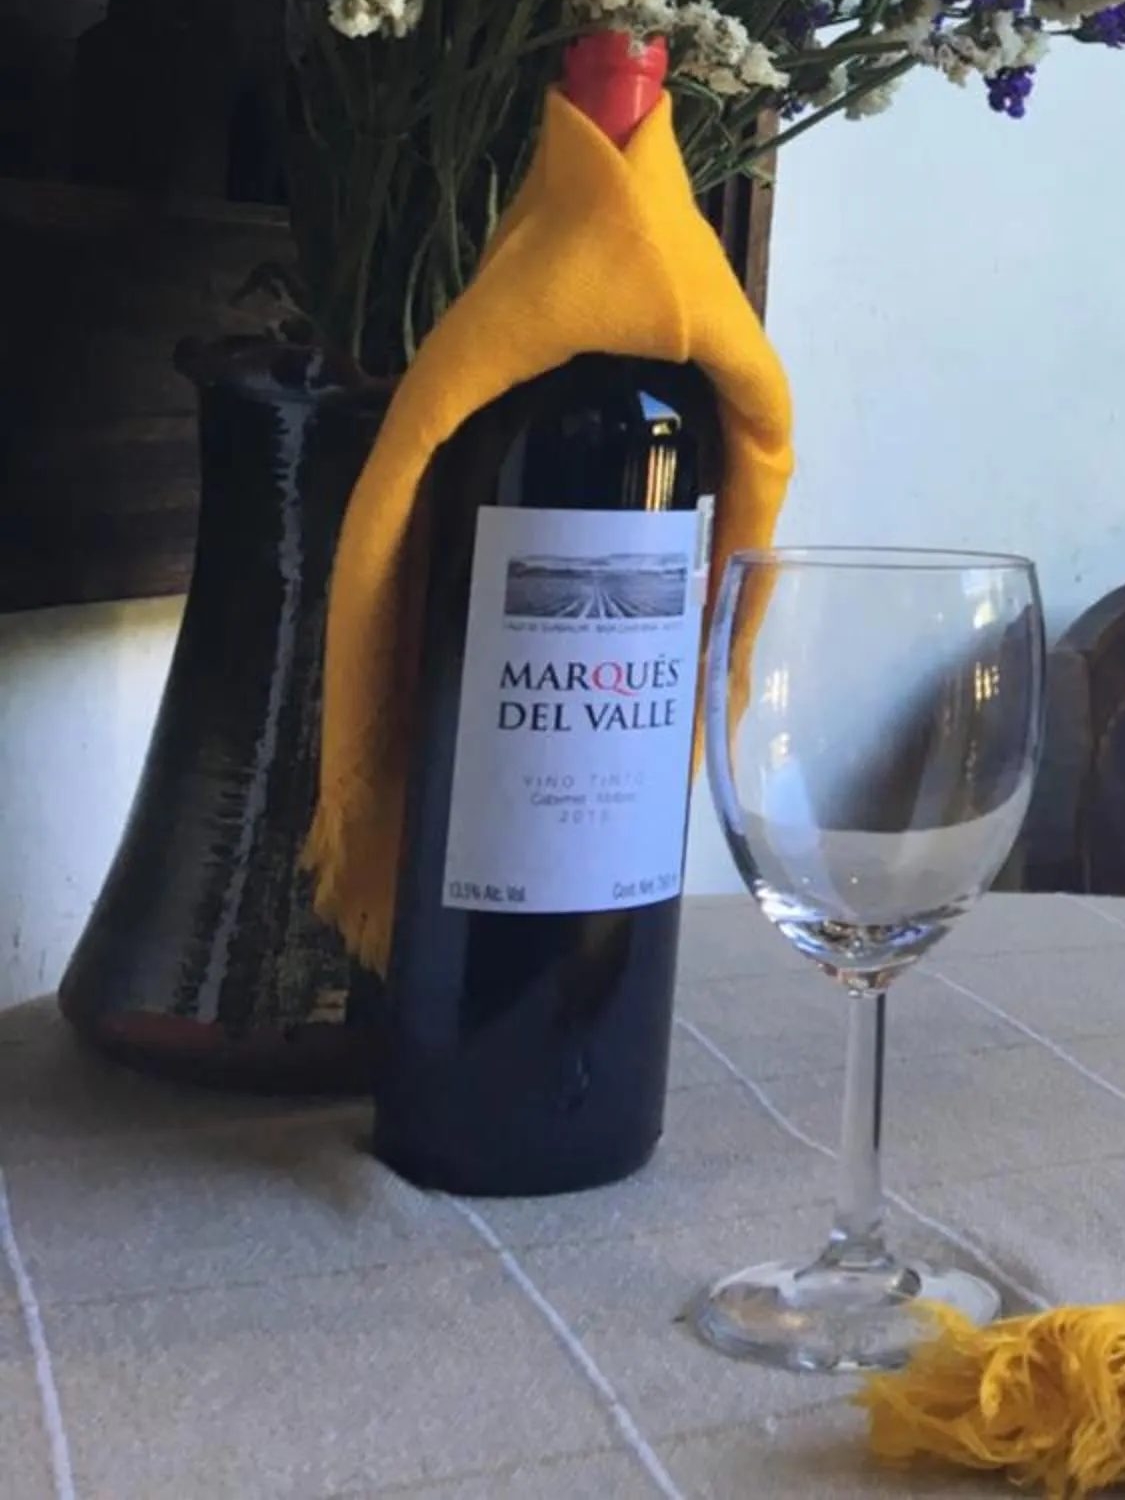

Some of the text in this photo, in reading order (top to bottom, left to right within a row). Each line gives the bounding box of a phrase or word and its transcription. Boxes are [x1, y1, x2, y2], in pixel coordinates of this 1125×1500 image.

[500, 655, 681, 697] MARQUÉS
[499, 699, 677, 732] DEL VALLE
[521, 773, 575, 790] VINO
